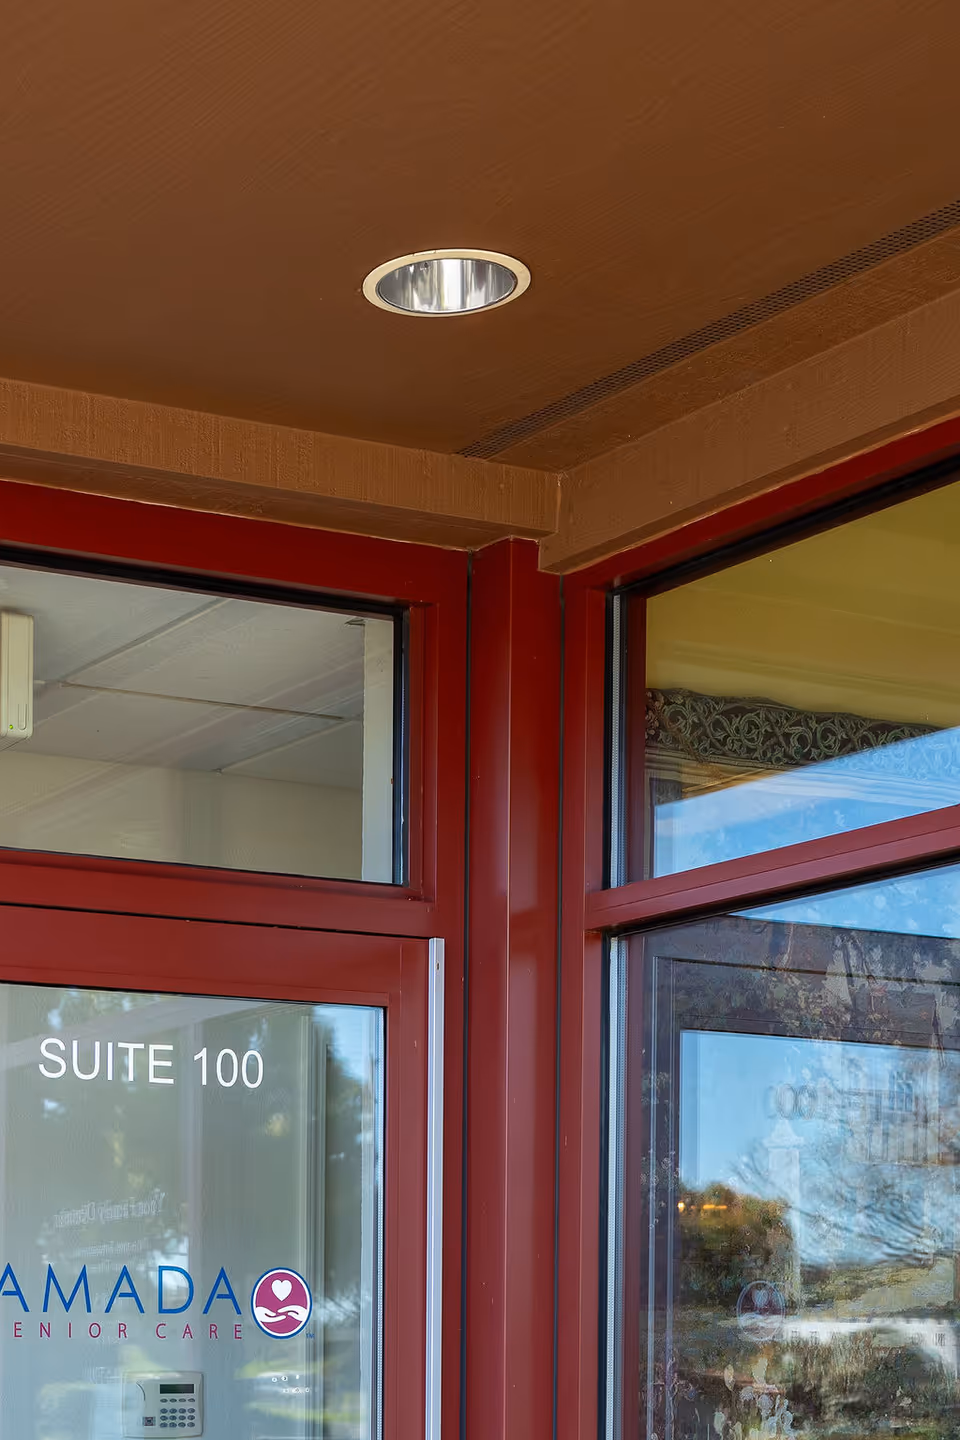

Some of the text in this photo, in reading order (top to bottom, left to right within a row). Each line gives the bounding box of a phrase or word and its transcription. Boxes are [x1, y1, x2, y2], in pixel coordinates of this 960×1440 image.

[38, 1037, 264, 1089] SUITE 100
[155, 1322, 243, 1341] CARE
